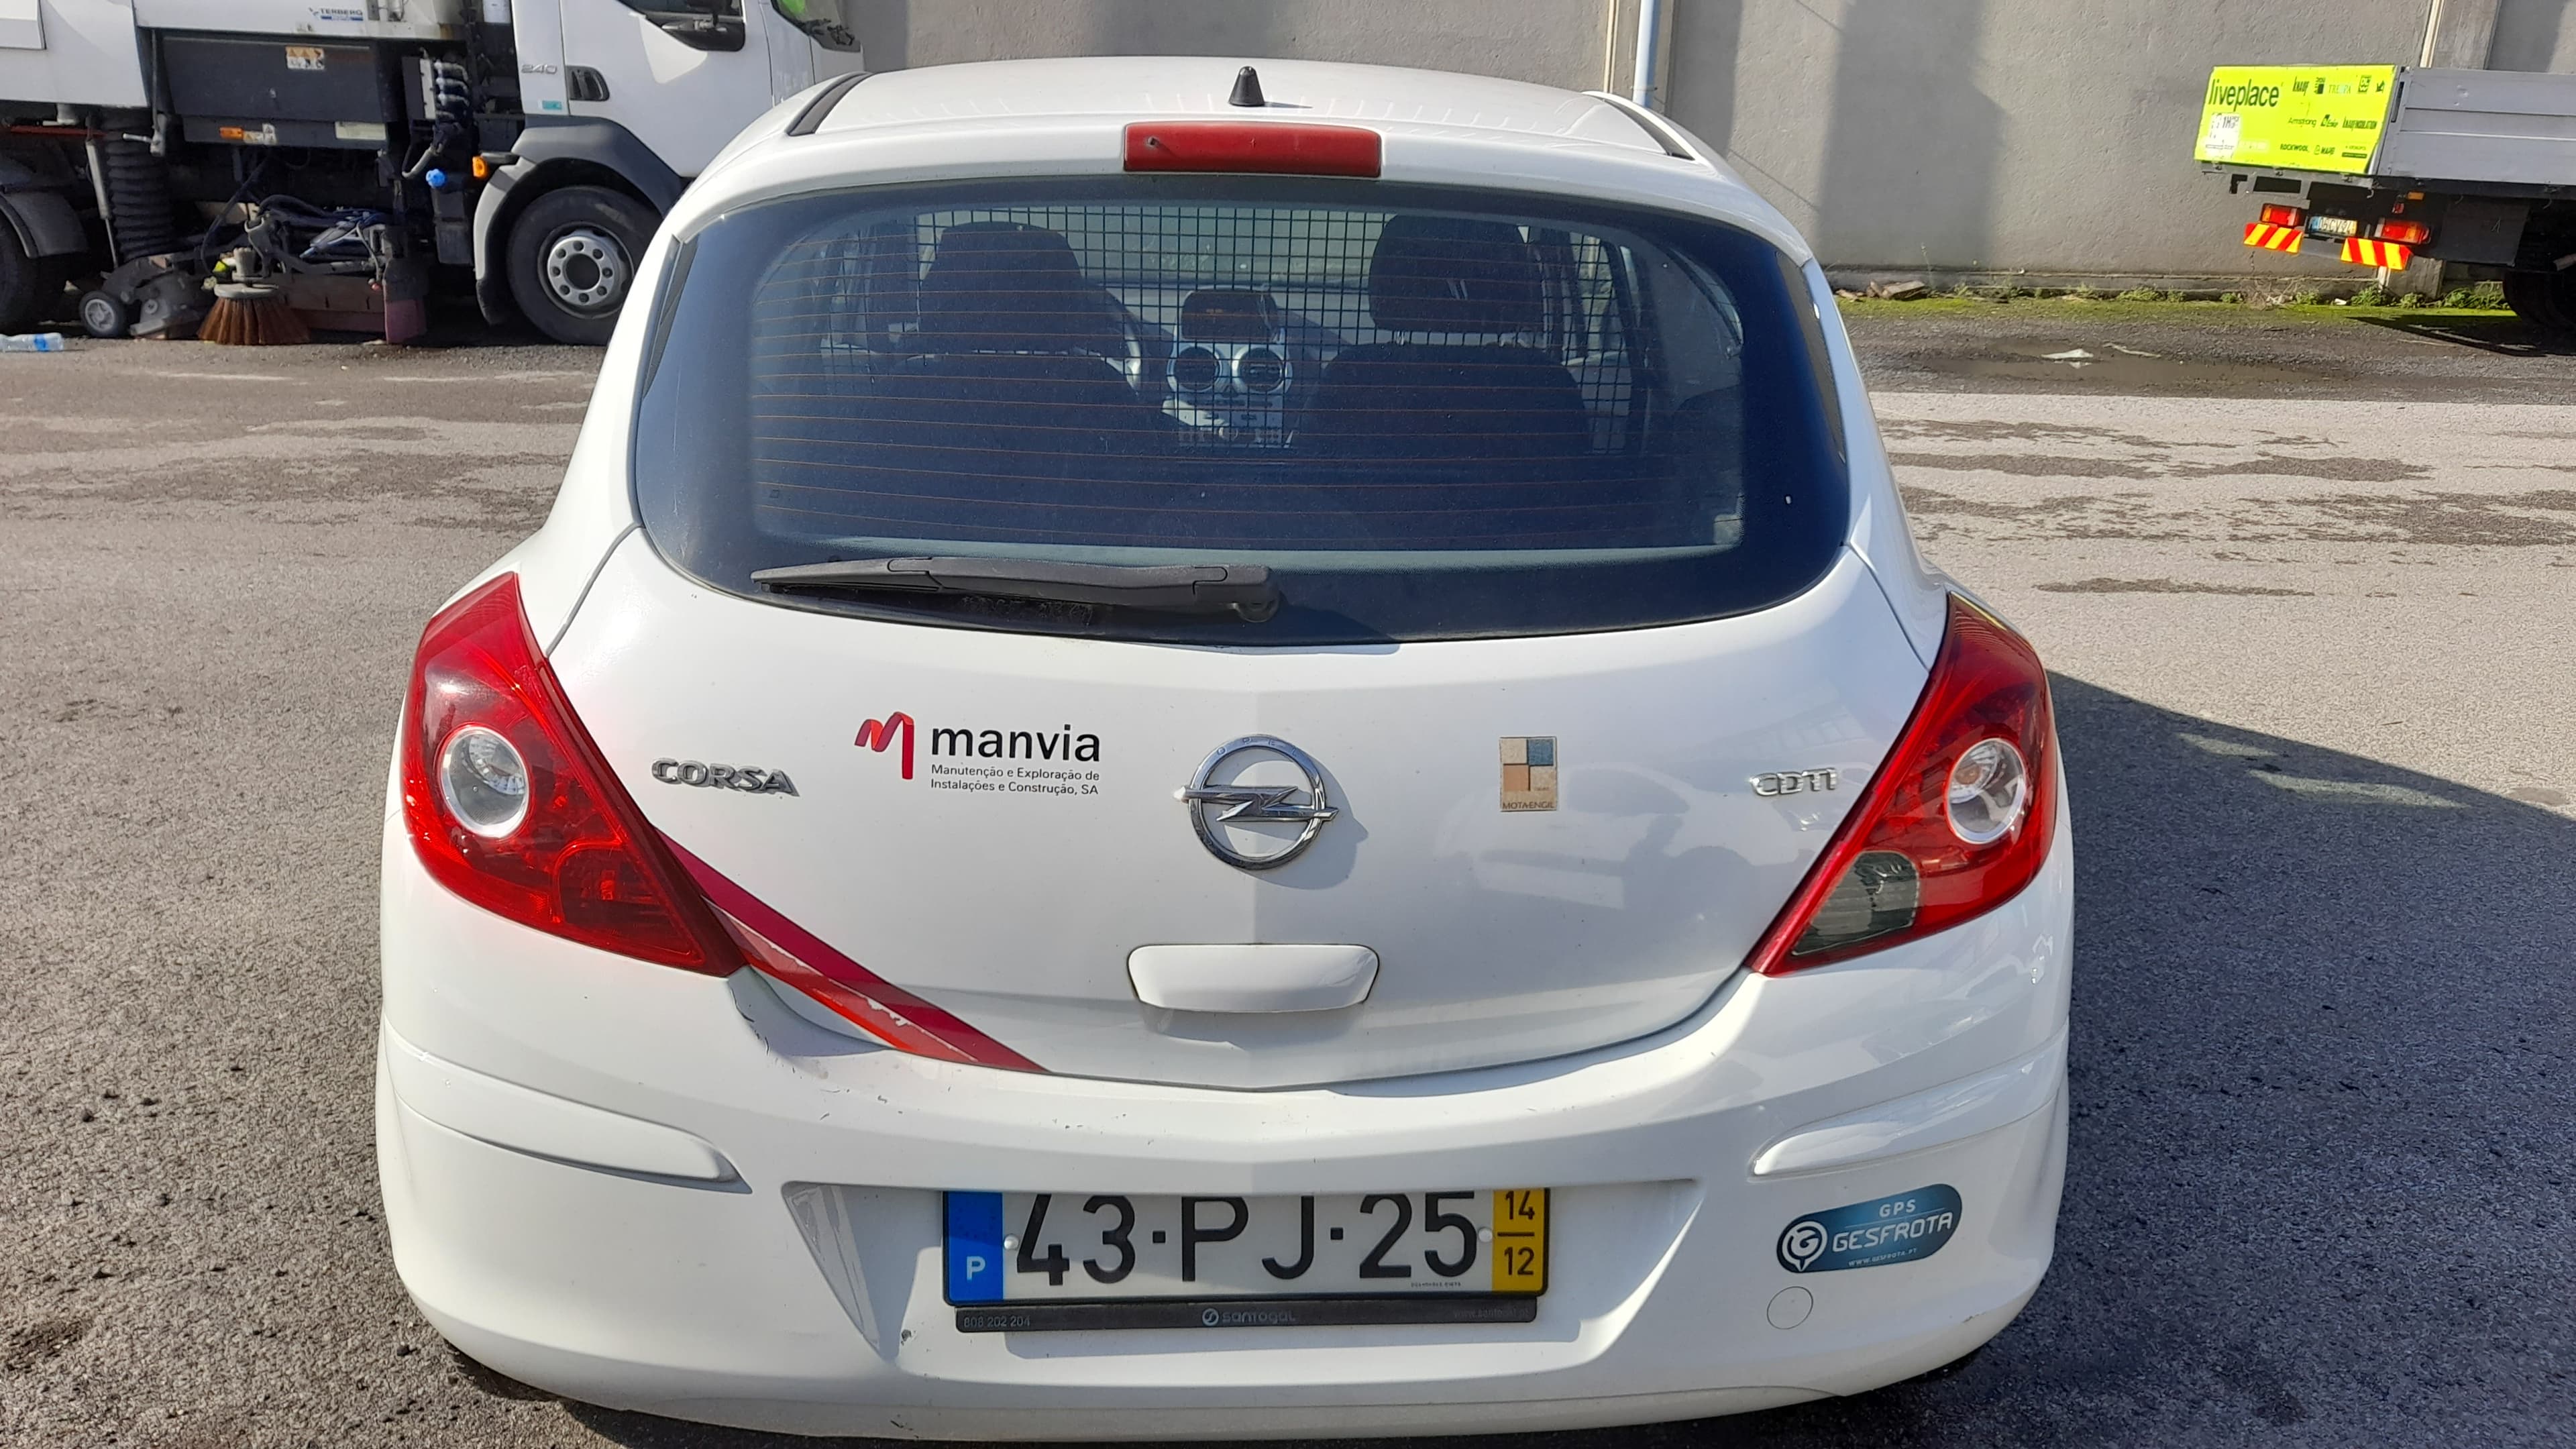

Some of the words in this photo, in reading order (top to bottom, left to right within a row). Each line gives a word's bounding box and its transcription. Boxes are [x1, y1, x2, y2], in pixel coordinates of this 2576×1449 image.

[521, 64, 557, 74] 240
[2208, 78, 2279, 112] liveplace
[2288, 118, 2316, 127] Armstrong
[931, 724, 1101, 762] manvia
[651, 757, 800, 798] CORSA
[931, 763, 1004, 778] Manutenção
[1007, 769, 1014, 777] e
[1017, 767, 1082, 782] Exploração
[1085, 771, 1099, 781] de
[1749, 767, 1837, 797] CDTI
[930, 778, 995, 792] Instalações
[998, 784, 1005, 792] e
[1008, 782, 1078, 796] Construção,
[1081, 784, 1099, 795] SA
[1505, 1191, 1536, 1220] 14
[1879, 1199, 1916, 1218] GPS
[1832, 1212, 1953, 1252] GESFROTA
[966, 1256, 985, 1281] P
[1505, 1246, 1535, 1276] 12
[987, 1316, 1008, 1328] 202
[1010, 1316, 1030, 1327] 204
